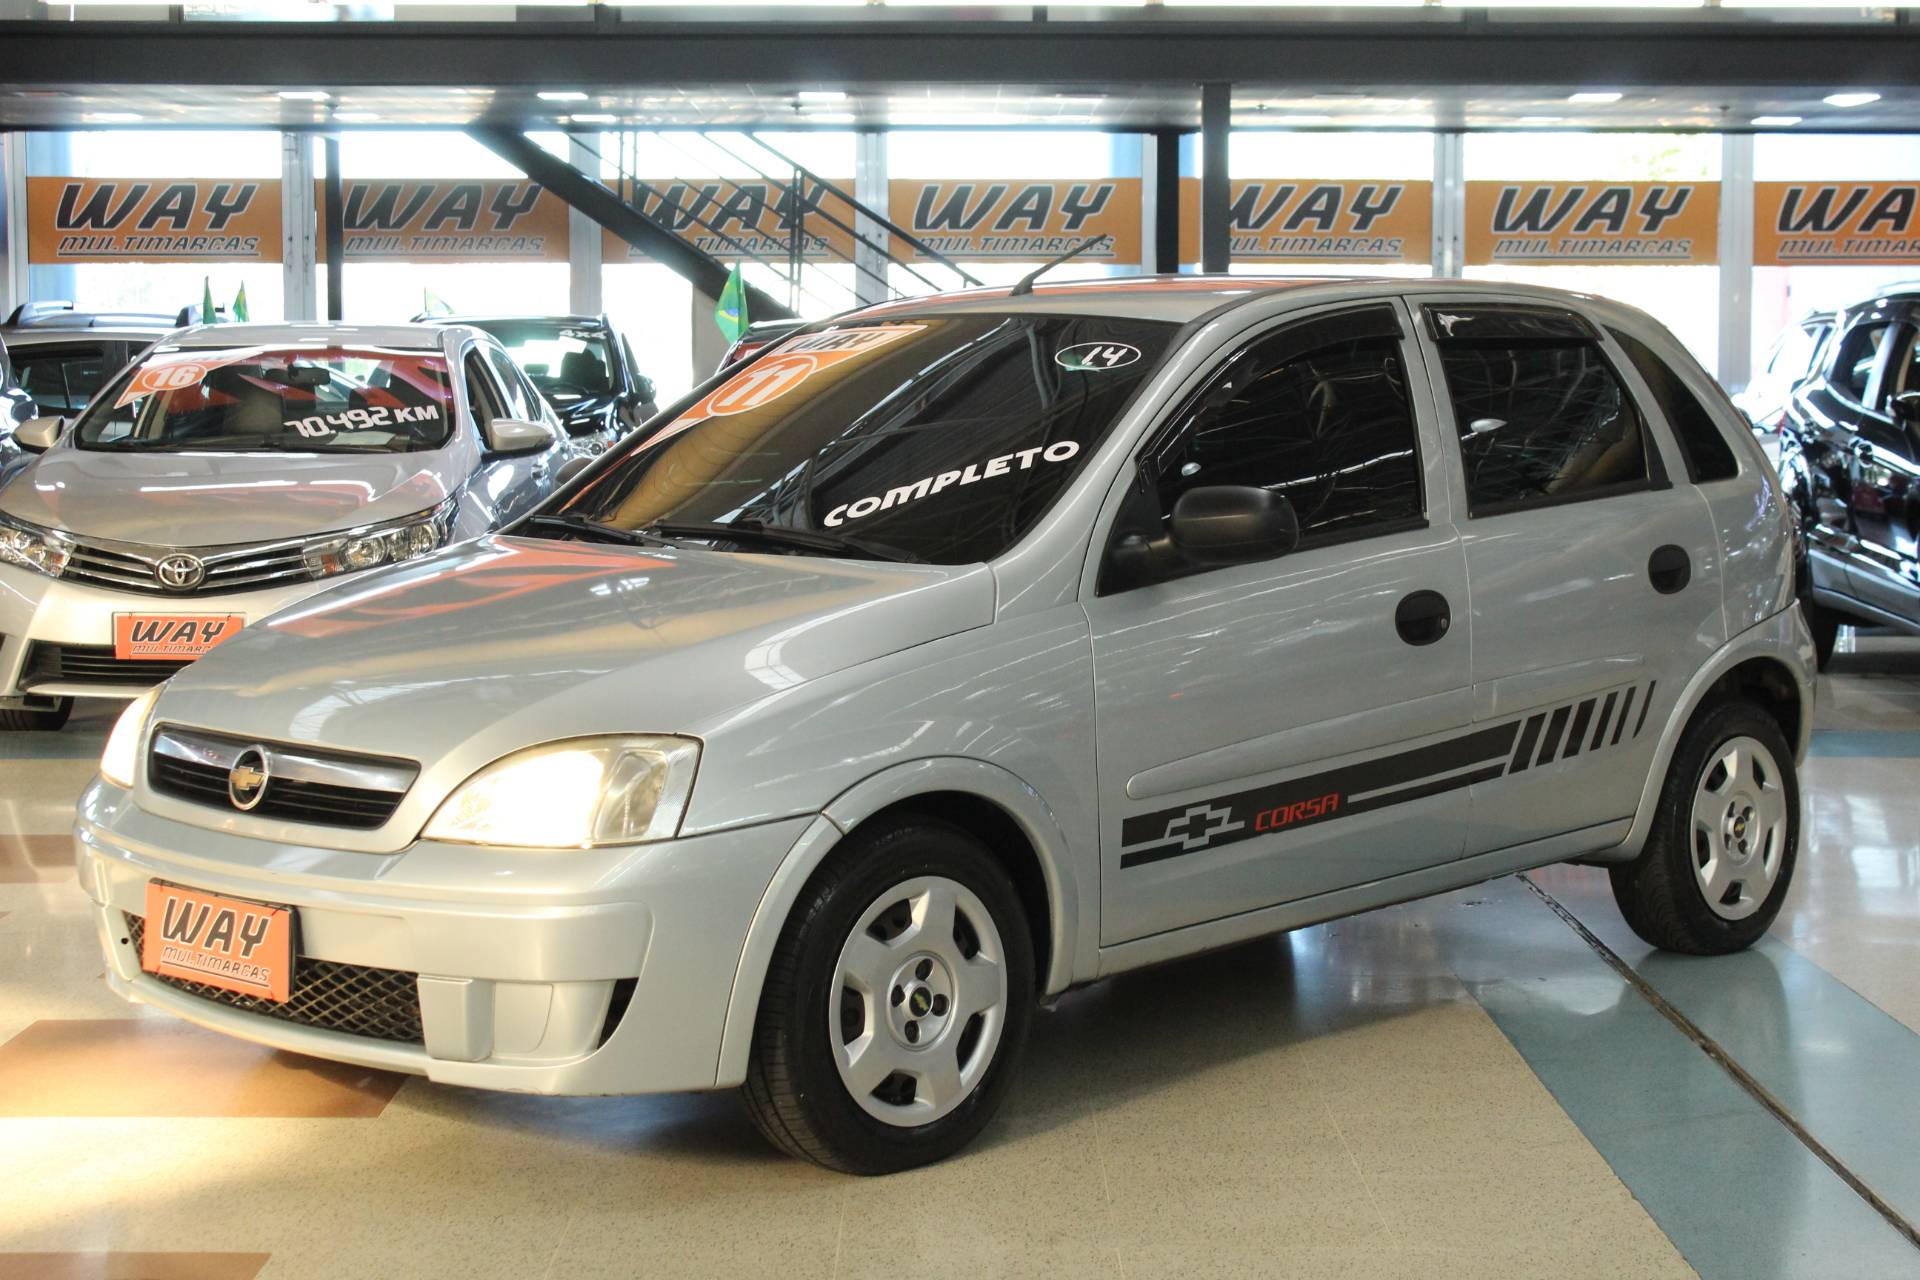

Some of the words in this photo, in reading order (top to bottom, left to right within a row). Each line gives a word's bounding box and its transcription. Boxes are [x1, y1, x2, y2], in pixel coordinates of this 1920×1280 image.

[56, 183, 259, 231] WAY
[343, 184, 544, 231] WAY
[632, 184, 828, 232] WAY
[912, 184, 1116, 232] WAY
[1491, 186, 1694, 234] WAY
[59, 236, 260, 251] MULTIMARCAS
[345, 236, 545, 251] MULTIMARCAS
[916, 236, 1115, 252] MULTIMARCAS
[1230, 236, 1402, 252] ULTIMARCAS
[1495, 238, 1692, 254] MULTIMARCAS
[152, 366, 200, 388] 16
[717, 363, 810, 407] 11
[394, 404, 440, 423] KM
[823, 440, 1080, 527] COMPLETO
[130, 620, 226, 644] WAY
[1254, 792, 1340, 832] CORSA
[161, 896, 271, 959] WAY
[161, 947, 271, 983] MULTIMARCAS
